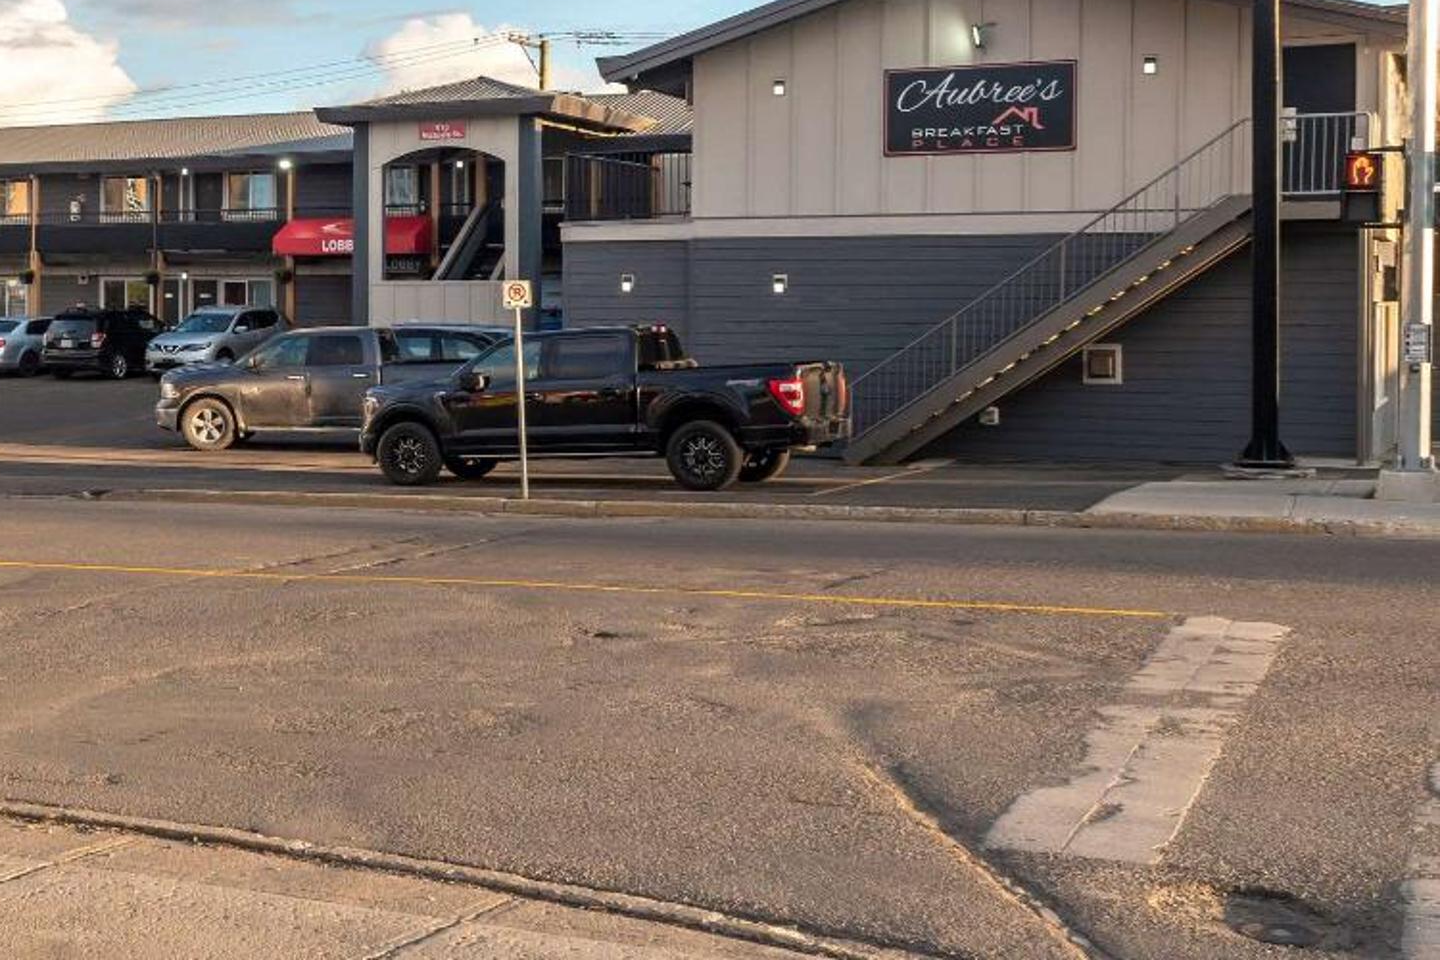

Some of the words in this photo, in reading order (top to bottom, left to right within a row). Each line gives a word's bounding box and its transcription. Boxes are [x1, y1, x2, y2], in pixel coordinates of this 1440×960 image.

[896, 72, 1064, 112] Aubree's
[911, 124, 1024, 139] BREAKFAST
[912, 135, 1024, 149] PLACE
[321, 239, 354, 253] LOBB
